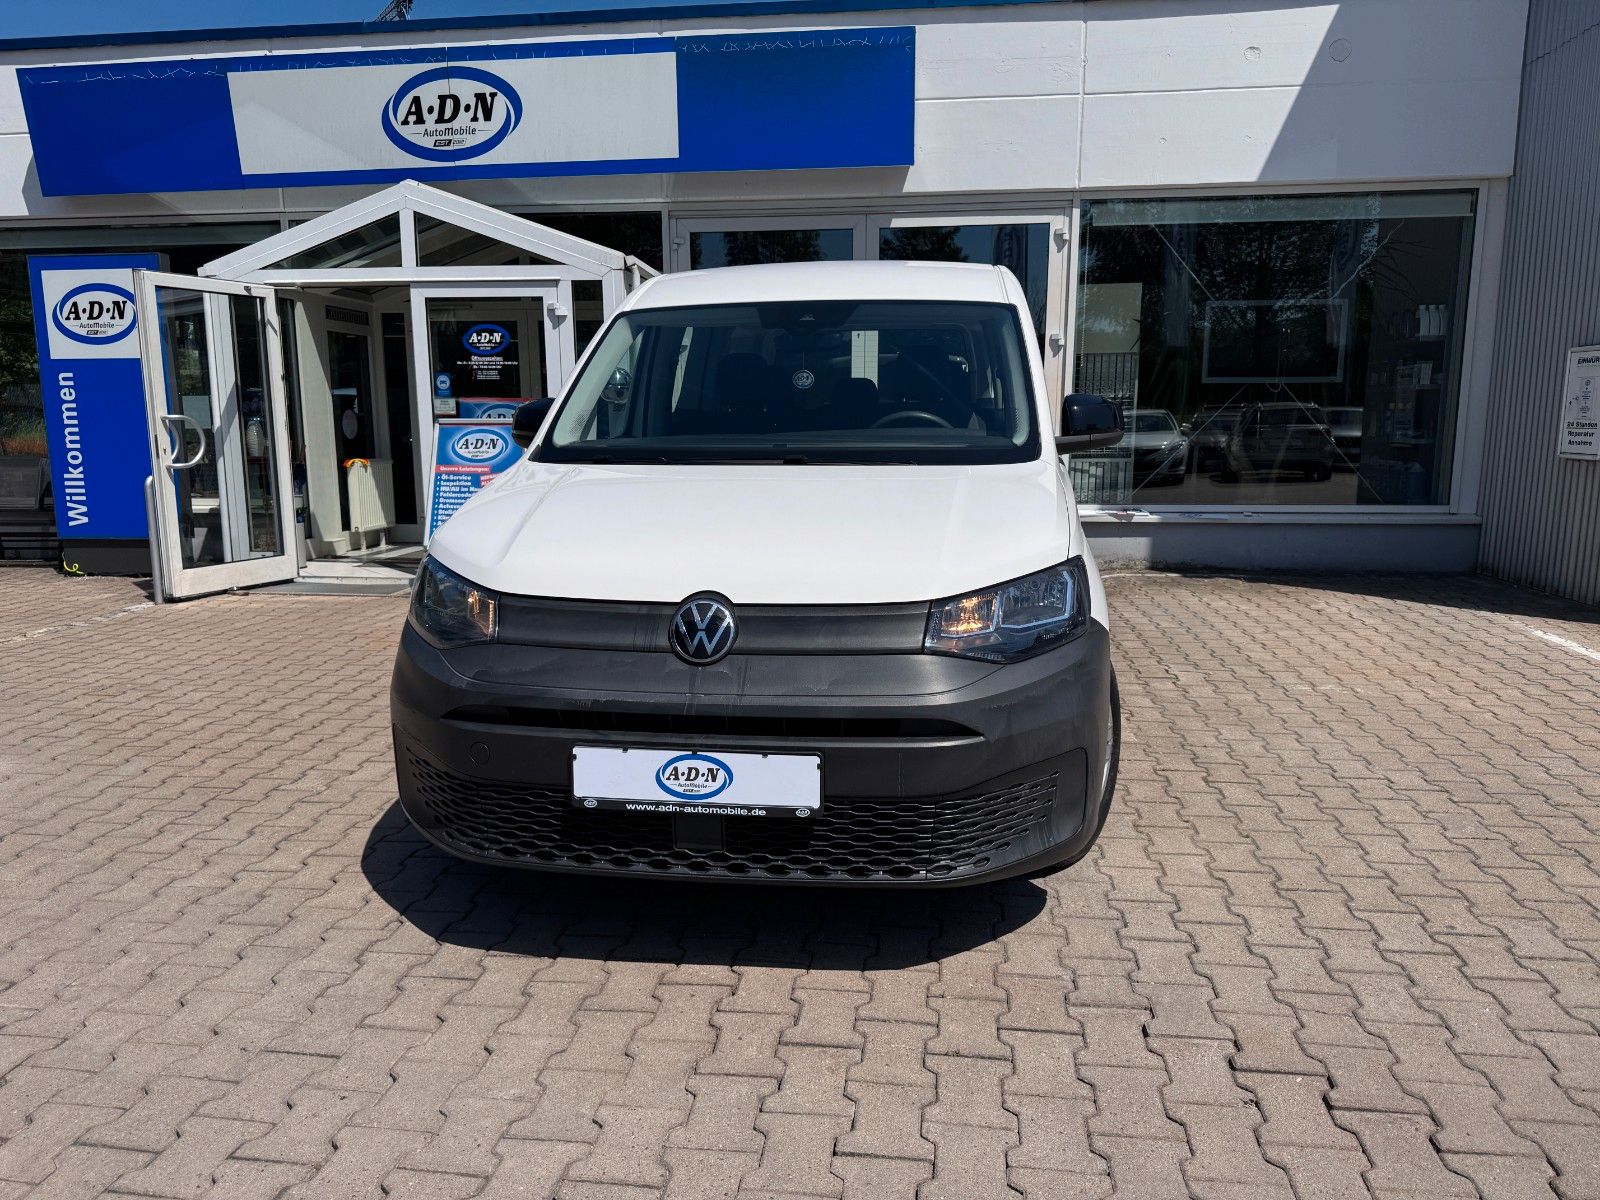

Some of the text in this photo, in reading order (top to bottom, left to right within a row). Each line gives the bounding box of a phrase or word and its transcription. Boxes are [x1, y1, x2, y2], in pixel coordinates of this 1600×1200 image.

[423, 126, 477, 138] AutoMobile
[58, 372, 89, 527] Willkommen
[625, 803, 767, 816] www.adn-automobile.de
